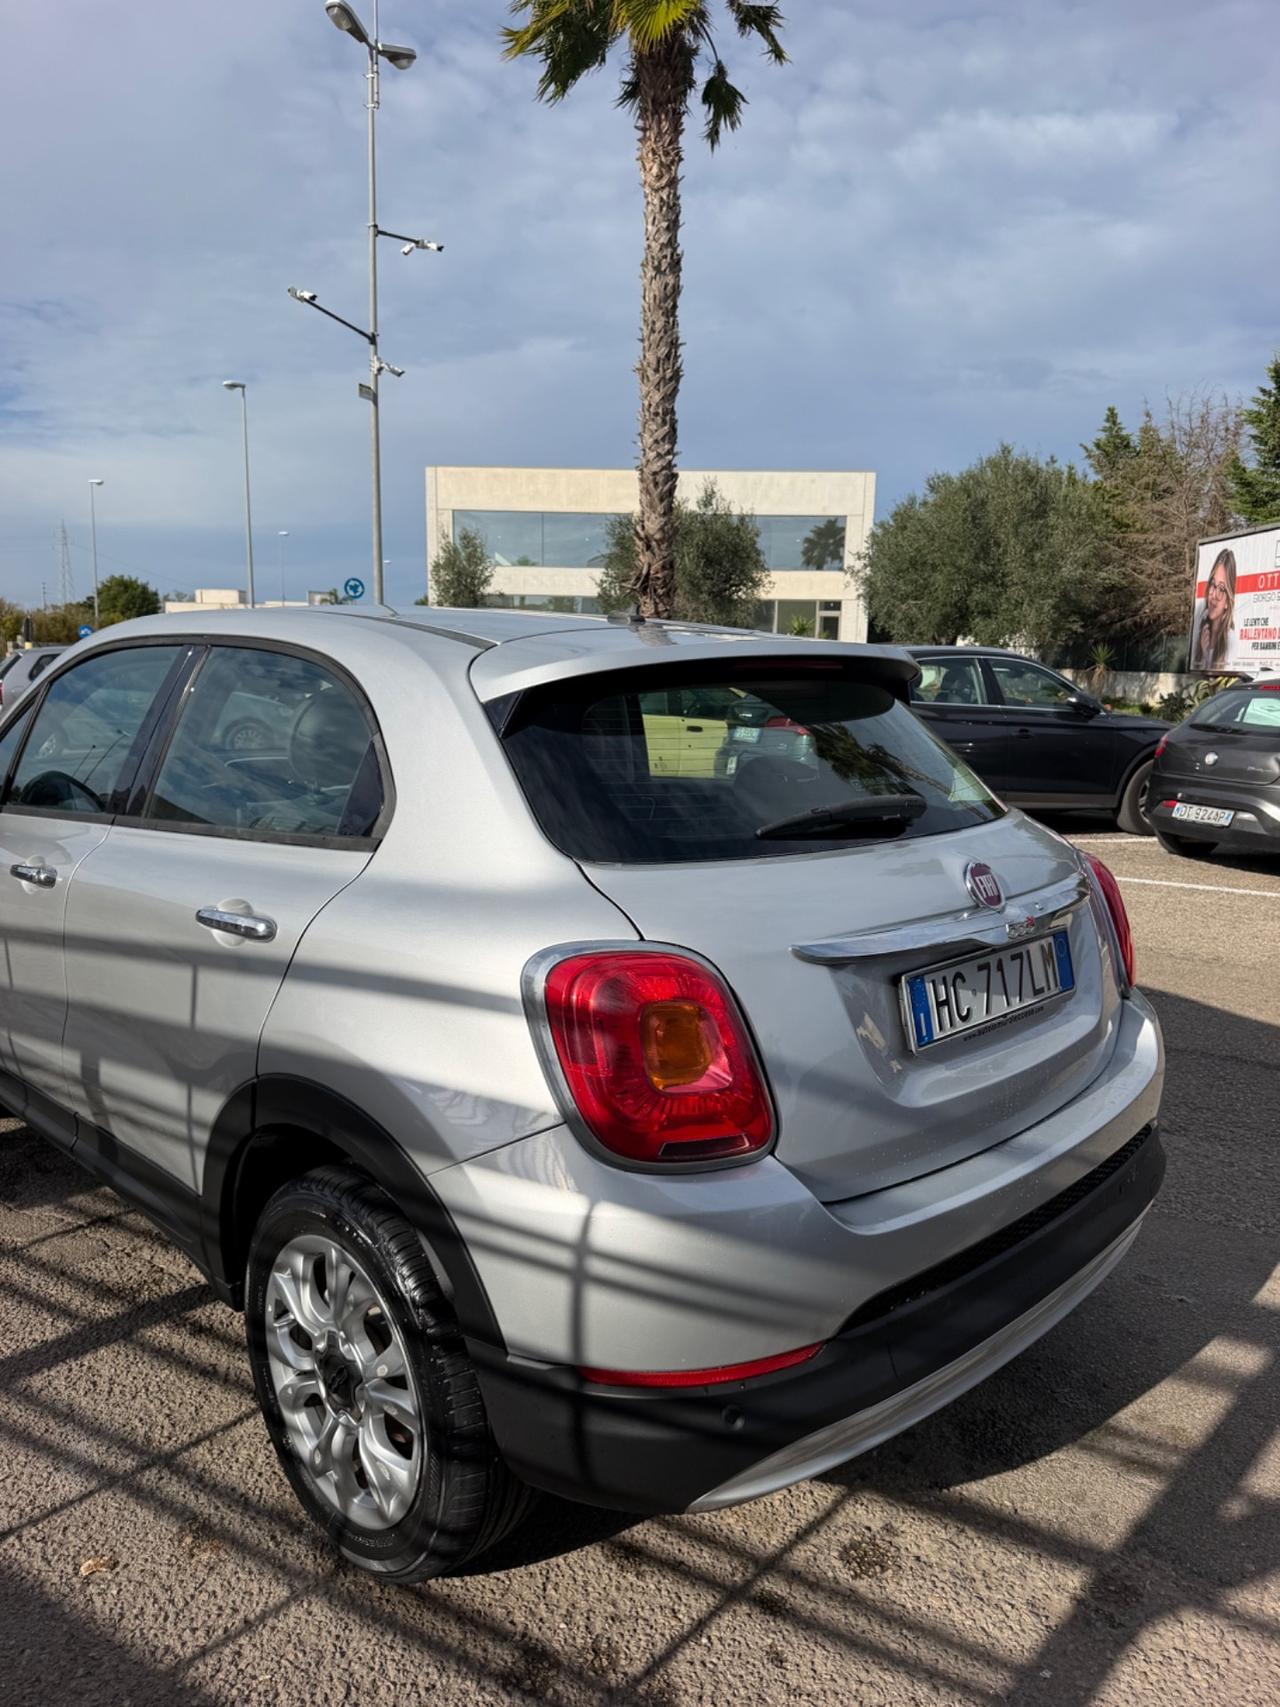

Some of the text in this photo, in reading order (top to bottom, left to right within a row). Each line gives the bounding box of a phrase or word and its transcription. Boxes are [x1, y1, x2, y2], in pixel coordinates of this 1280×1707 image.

[1260, 617, 1269, 626] CHE
[1240, 627, 1277, 640] RALLENTANO
[974, 873, 999, 898] FIAT
